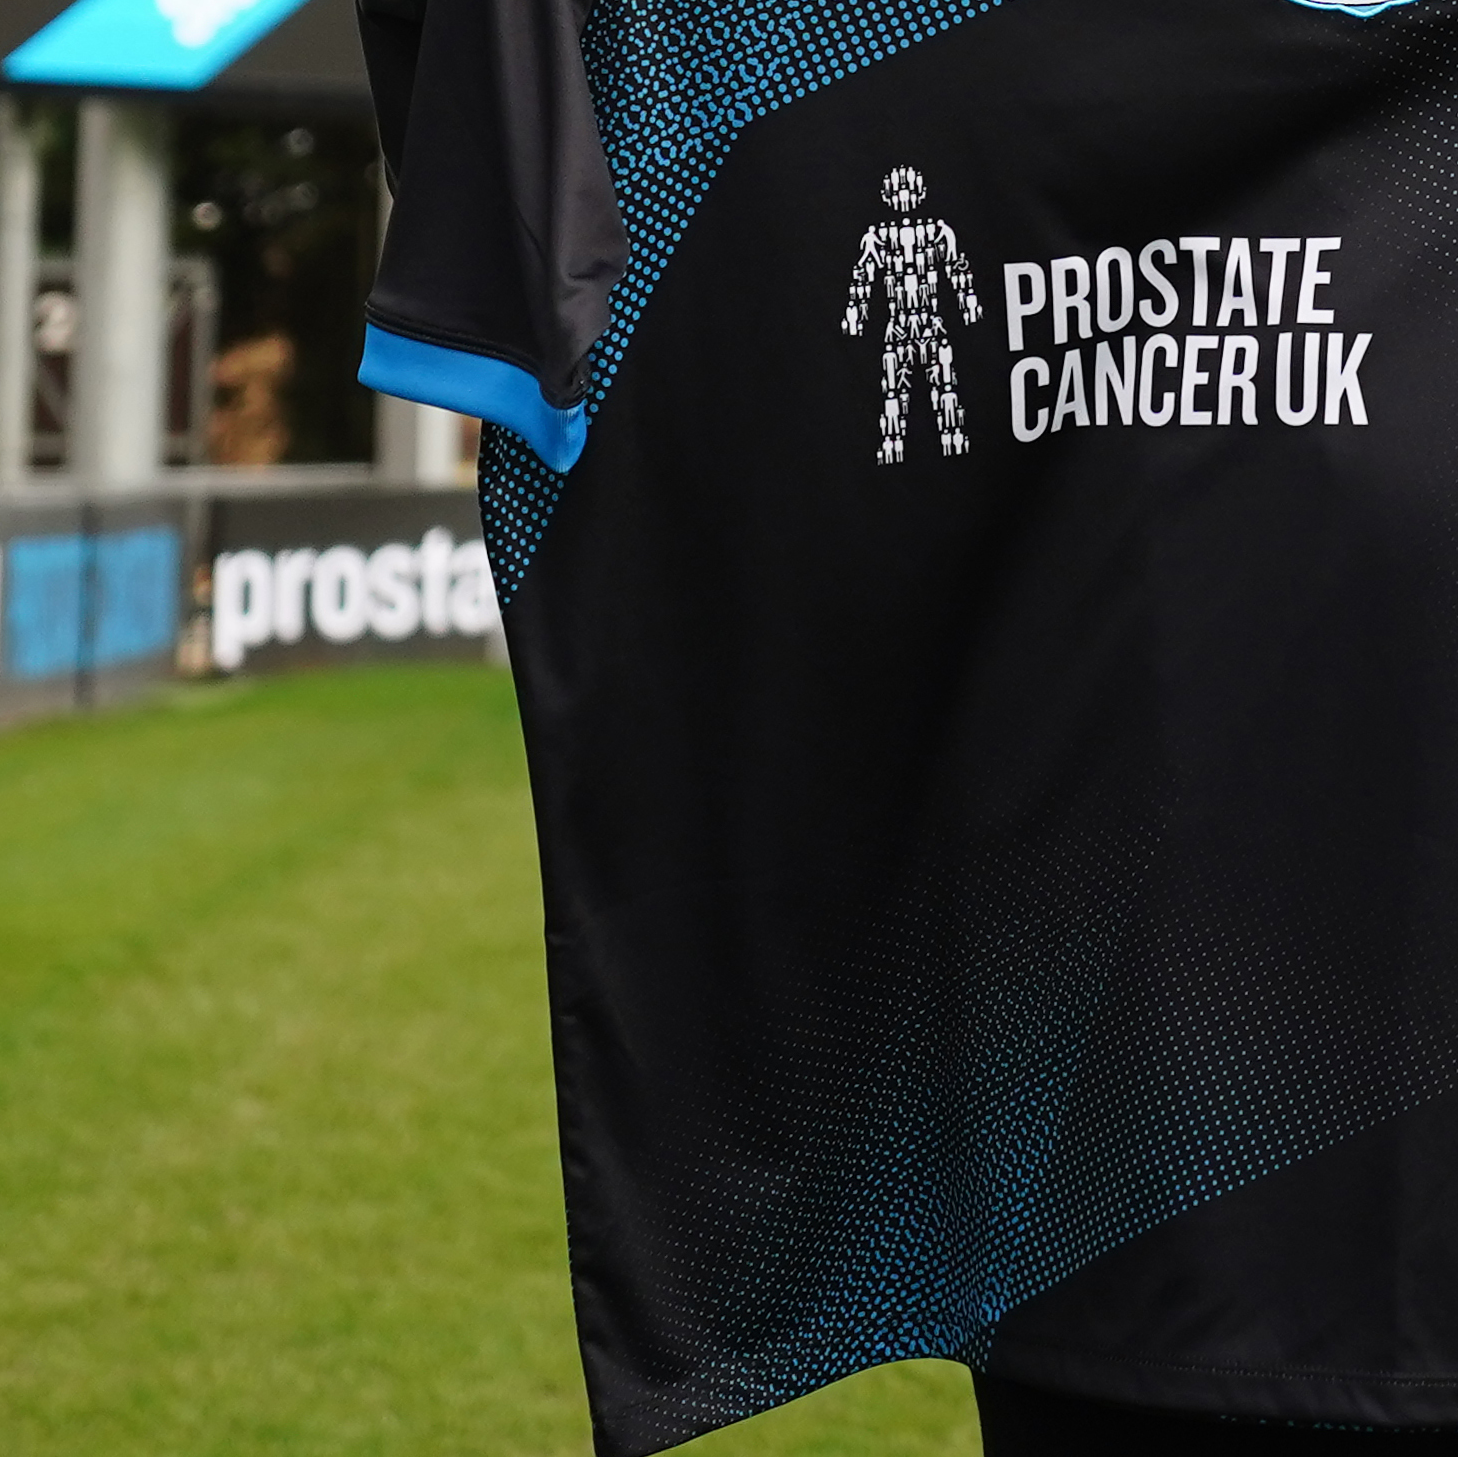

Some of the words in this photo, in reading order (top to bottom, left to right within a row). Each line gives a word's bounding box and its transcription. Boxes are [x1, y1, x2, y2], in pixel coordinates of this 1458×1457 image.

[1003, 236, 1342, 352] PROSTATE
[1009, 333, 1259, 443] CANCER
[1274, 332, 1373, 427] UK
